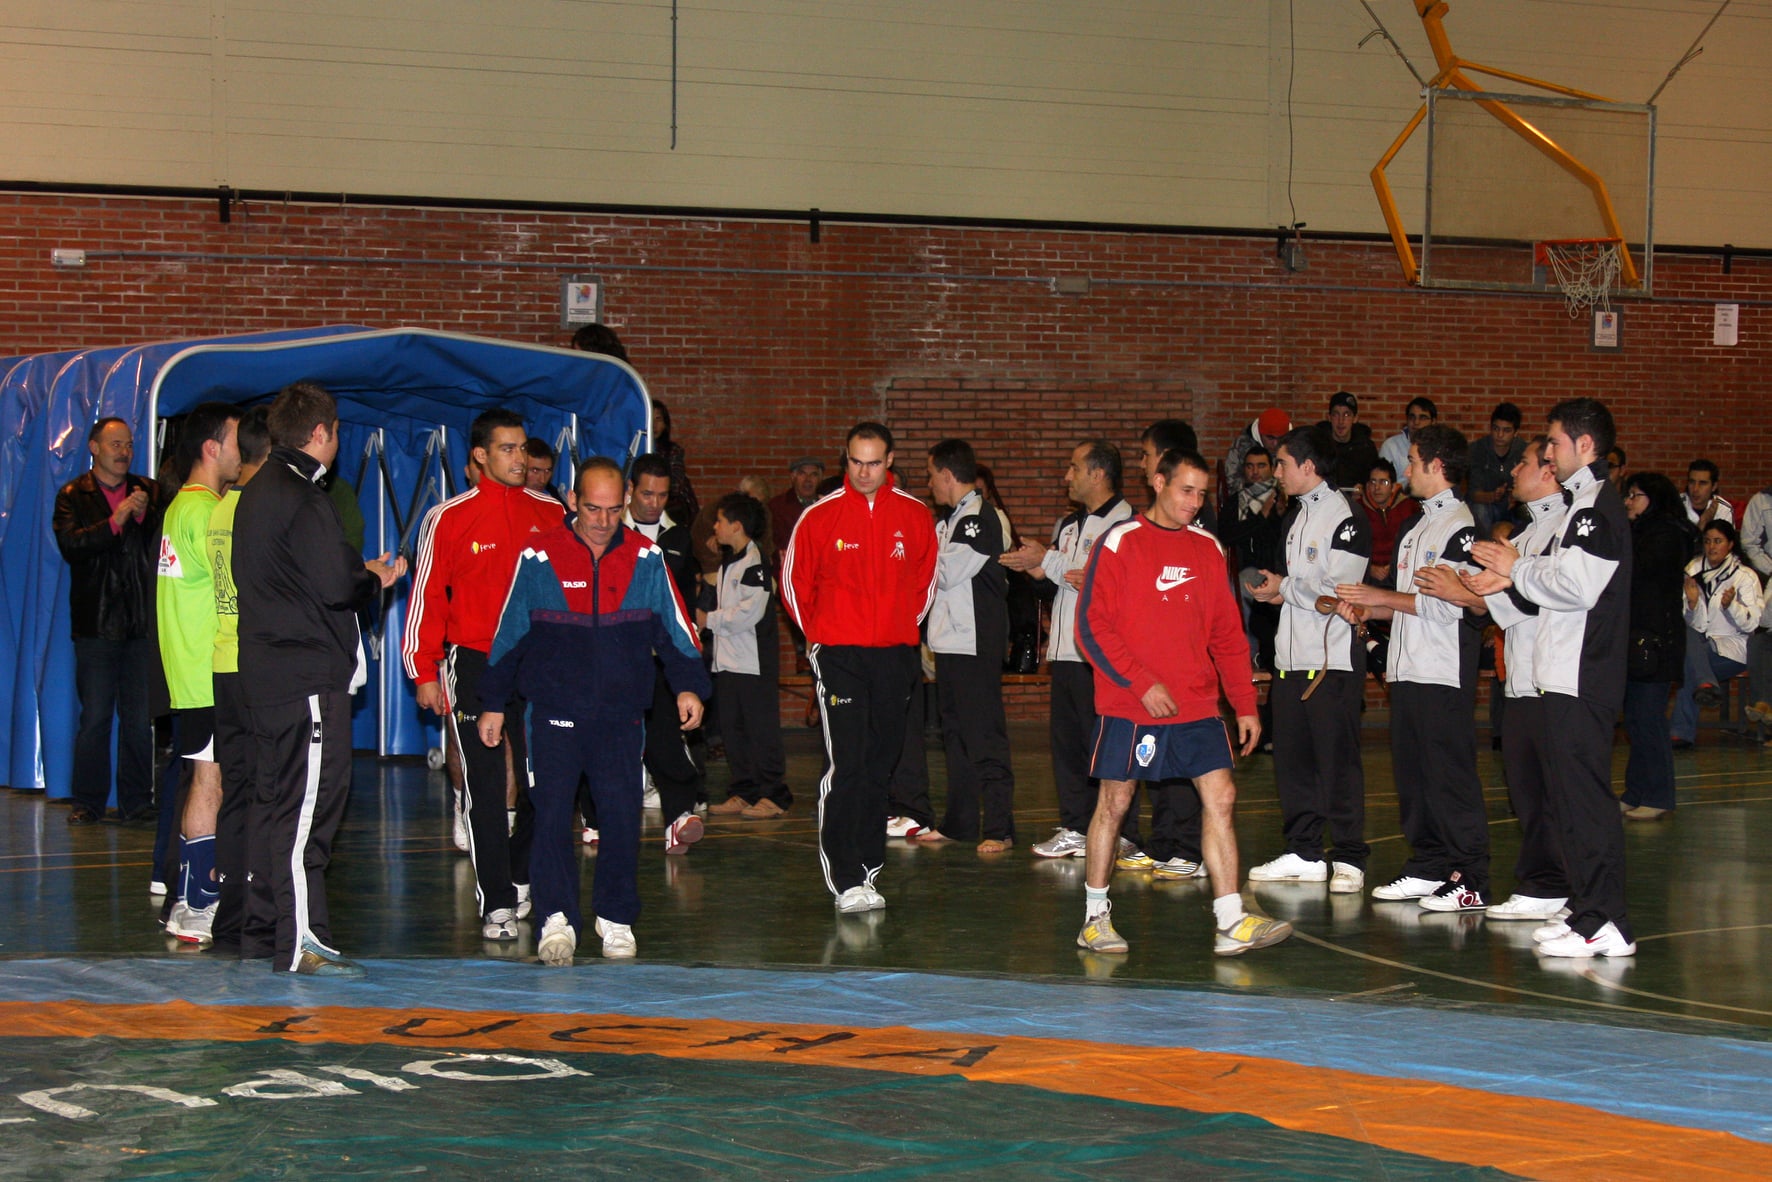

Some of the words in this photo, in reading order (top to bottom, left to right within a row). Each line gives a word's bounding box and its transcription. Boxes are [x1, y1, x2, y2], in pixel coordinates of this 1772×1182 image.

[1161, 565, 1188, 580] NIKE
[549, 719, 574, 728] TASIO
[0, 1053, 594, 1124] DIPU
